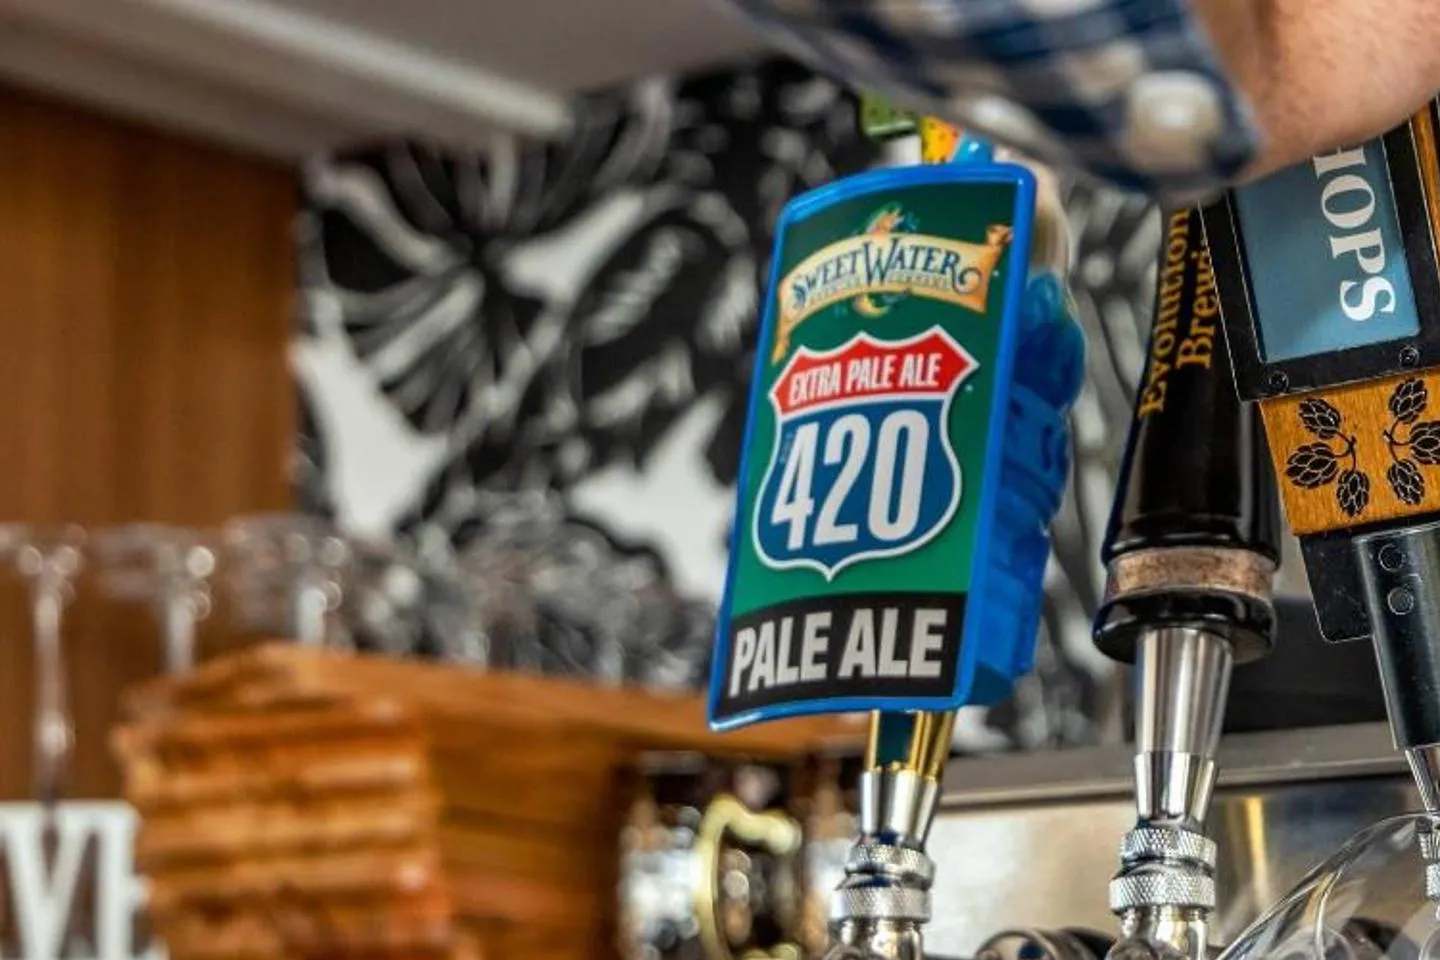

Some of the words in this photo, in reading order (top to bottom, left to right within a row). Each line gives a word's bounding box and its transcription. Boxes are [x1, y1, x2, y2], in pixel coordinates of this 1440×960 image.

[1138, 208, 1190, 419] Evolution
[788, 361, 844, 407] EXTRA
[845, 354, 897, 392] PALE
[900, 352, 943, 388] ALE
[771, 409, 930, 551] 420
[729, 611, 832, 697] PALE
[837, 607, 948, 680] ALE
